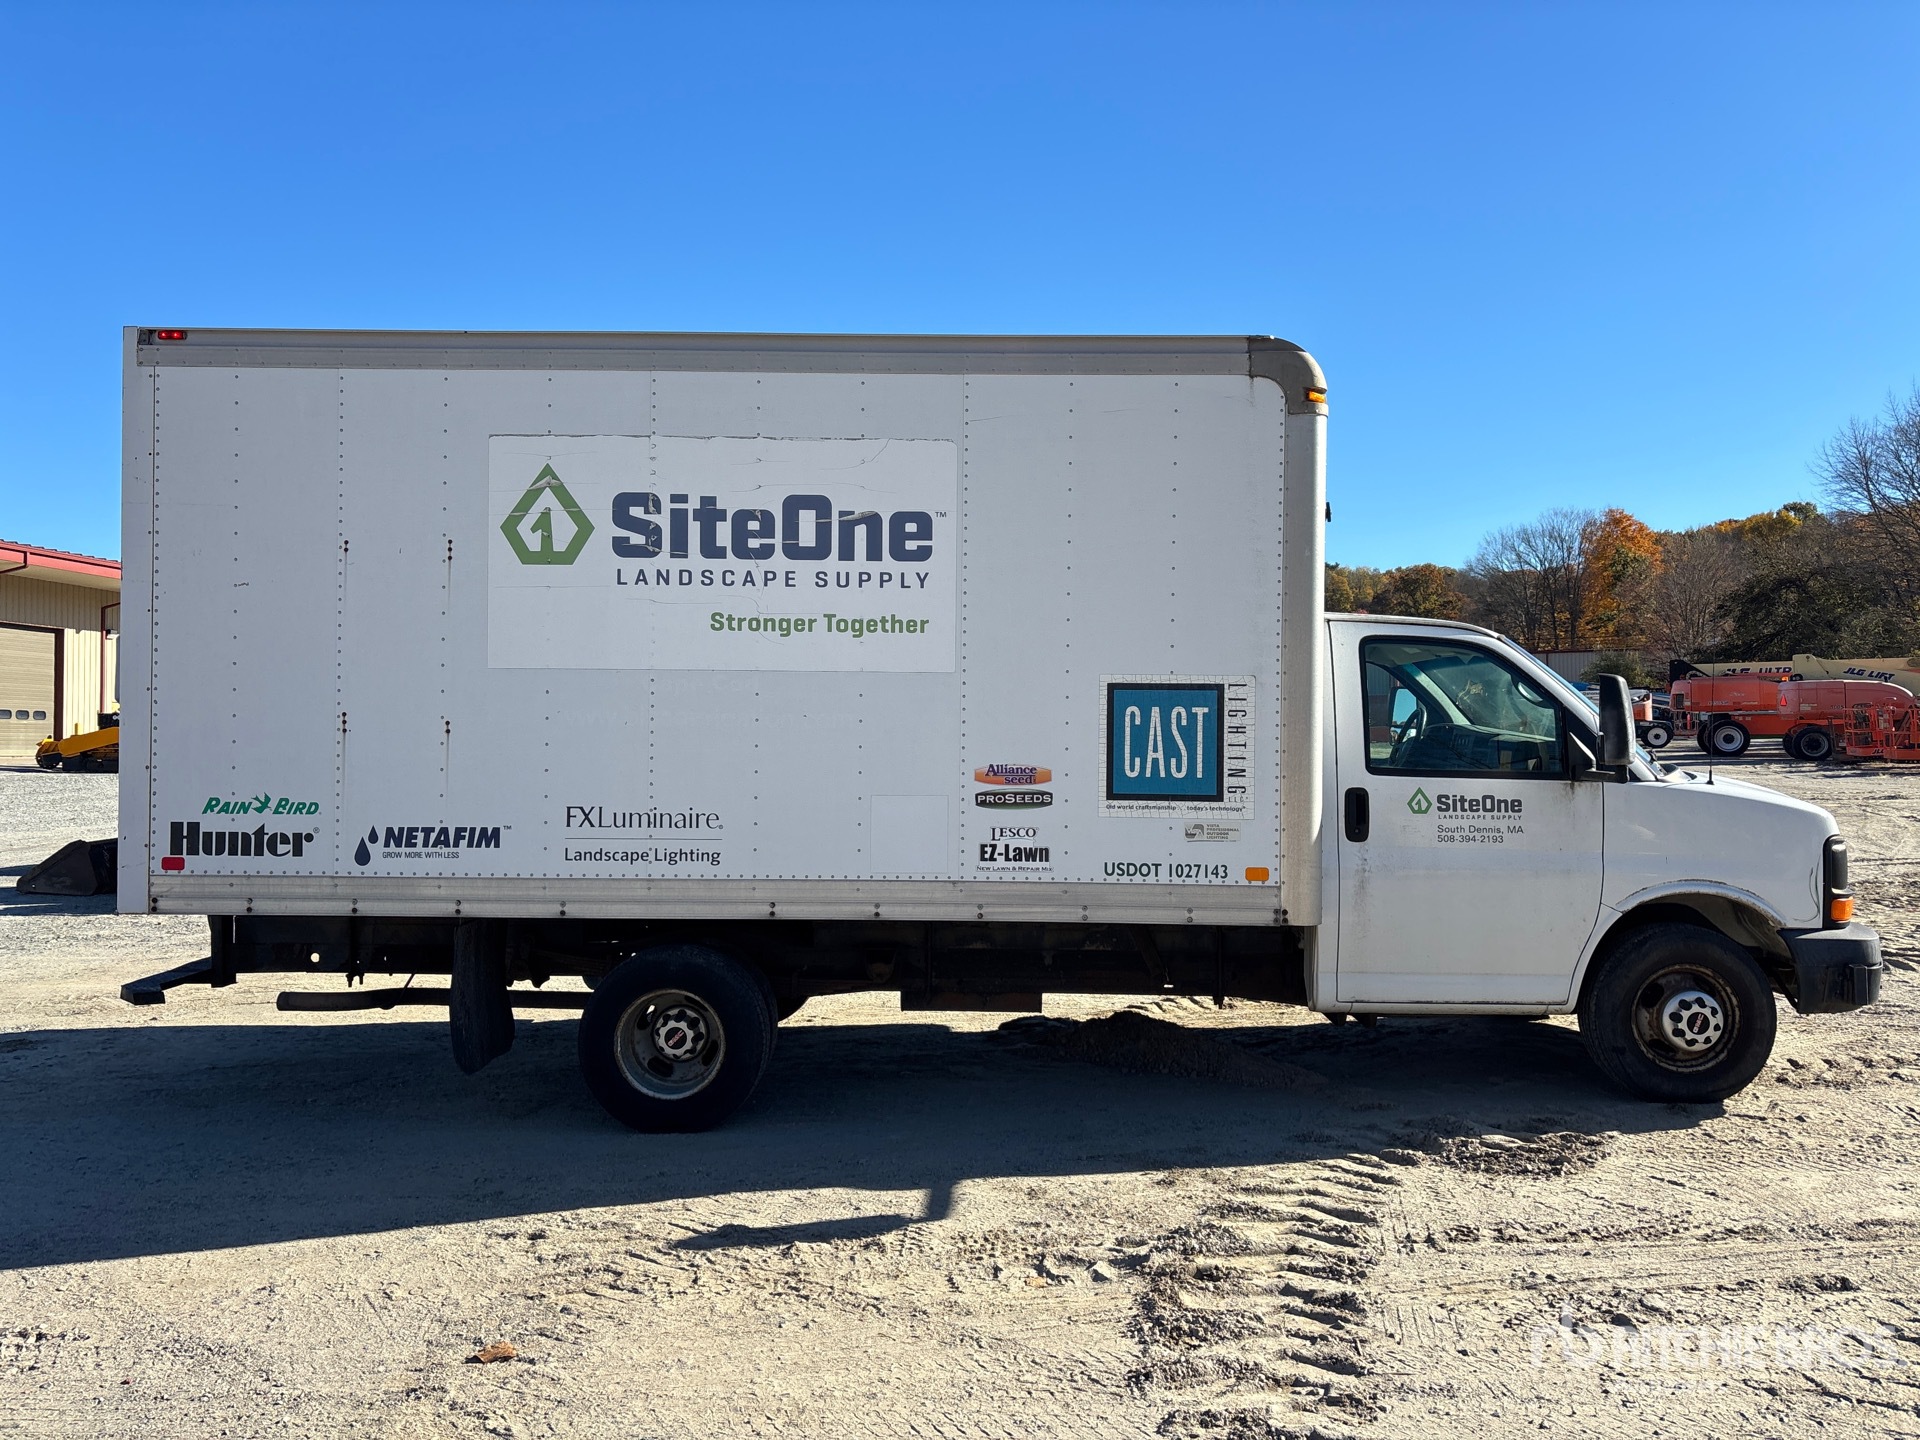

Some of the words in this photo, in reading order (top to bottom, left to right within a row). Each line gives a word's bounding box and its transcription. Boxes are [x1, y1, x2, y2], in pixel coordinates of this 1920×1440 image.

[612, 492, 933, 562] SiteOne
[616, 568, 797, 588] LANDSCAPE
[814, 571, 930, 589] SUPPLY
[710, 612, 817, 637] Stronger
[823, 613, 930, 638] Together
[1843, 667, 1866, 677] JLG
[1867, 669, 1895, 680] LIFT
[1124, 705, 1209, 779] CAST
[1227, 683, 1248, 794] LIGHTING
[985, 764, 1037, 776] Alliance
[1004, 775, 1033, 784] seed
[201, 796, 251, 815] RAIN
[272, 797, 320, 815] BIRD
[977, 794, 1052, 804] PROSEEDS
[1436, 794, 1523, 813] SiteOne
[565, 806, 720, 829] FXLuminaire
[169, 821, 314, 857] Hunter
[383, 826, 501, 849] NETAFIM
[991, 827, 1037, 841] LESCO
[1437, 825, 1466, 834] South
[1468, 825, 1504, 835] Dennis,
[1507, 826, 1524, 834] MA
[1437, 834, 1504, 843] 508-394-2193
[382, 851, 402, 859] GROW
[404, 851, 423, 859] MORE
[425, 851, 443, 859] WITH
[443, 851, 460, 859] LESS
[564, 847, 650, 865] Landscape
[654, 848, 721, 866] Lighting
[980, 843, 1050, 862] EZ-Lawn
[1104, 862, 1162, 877] USDOT
[1168, 863, 1229, 879] 1027143
